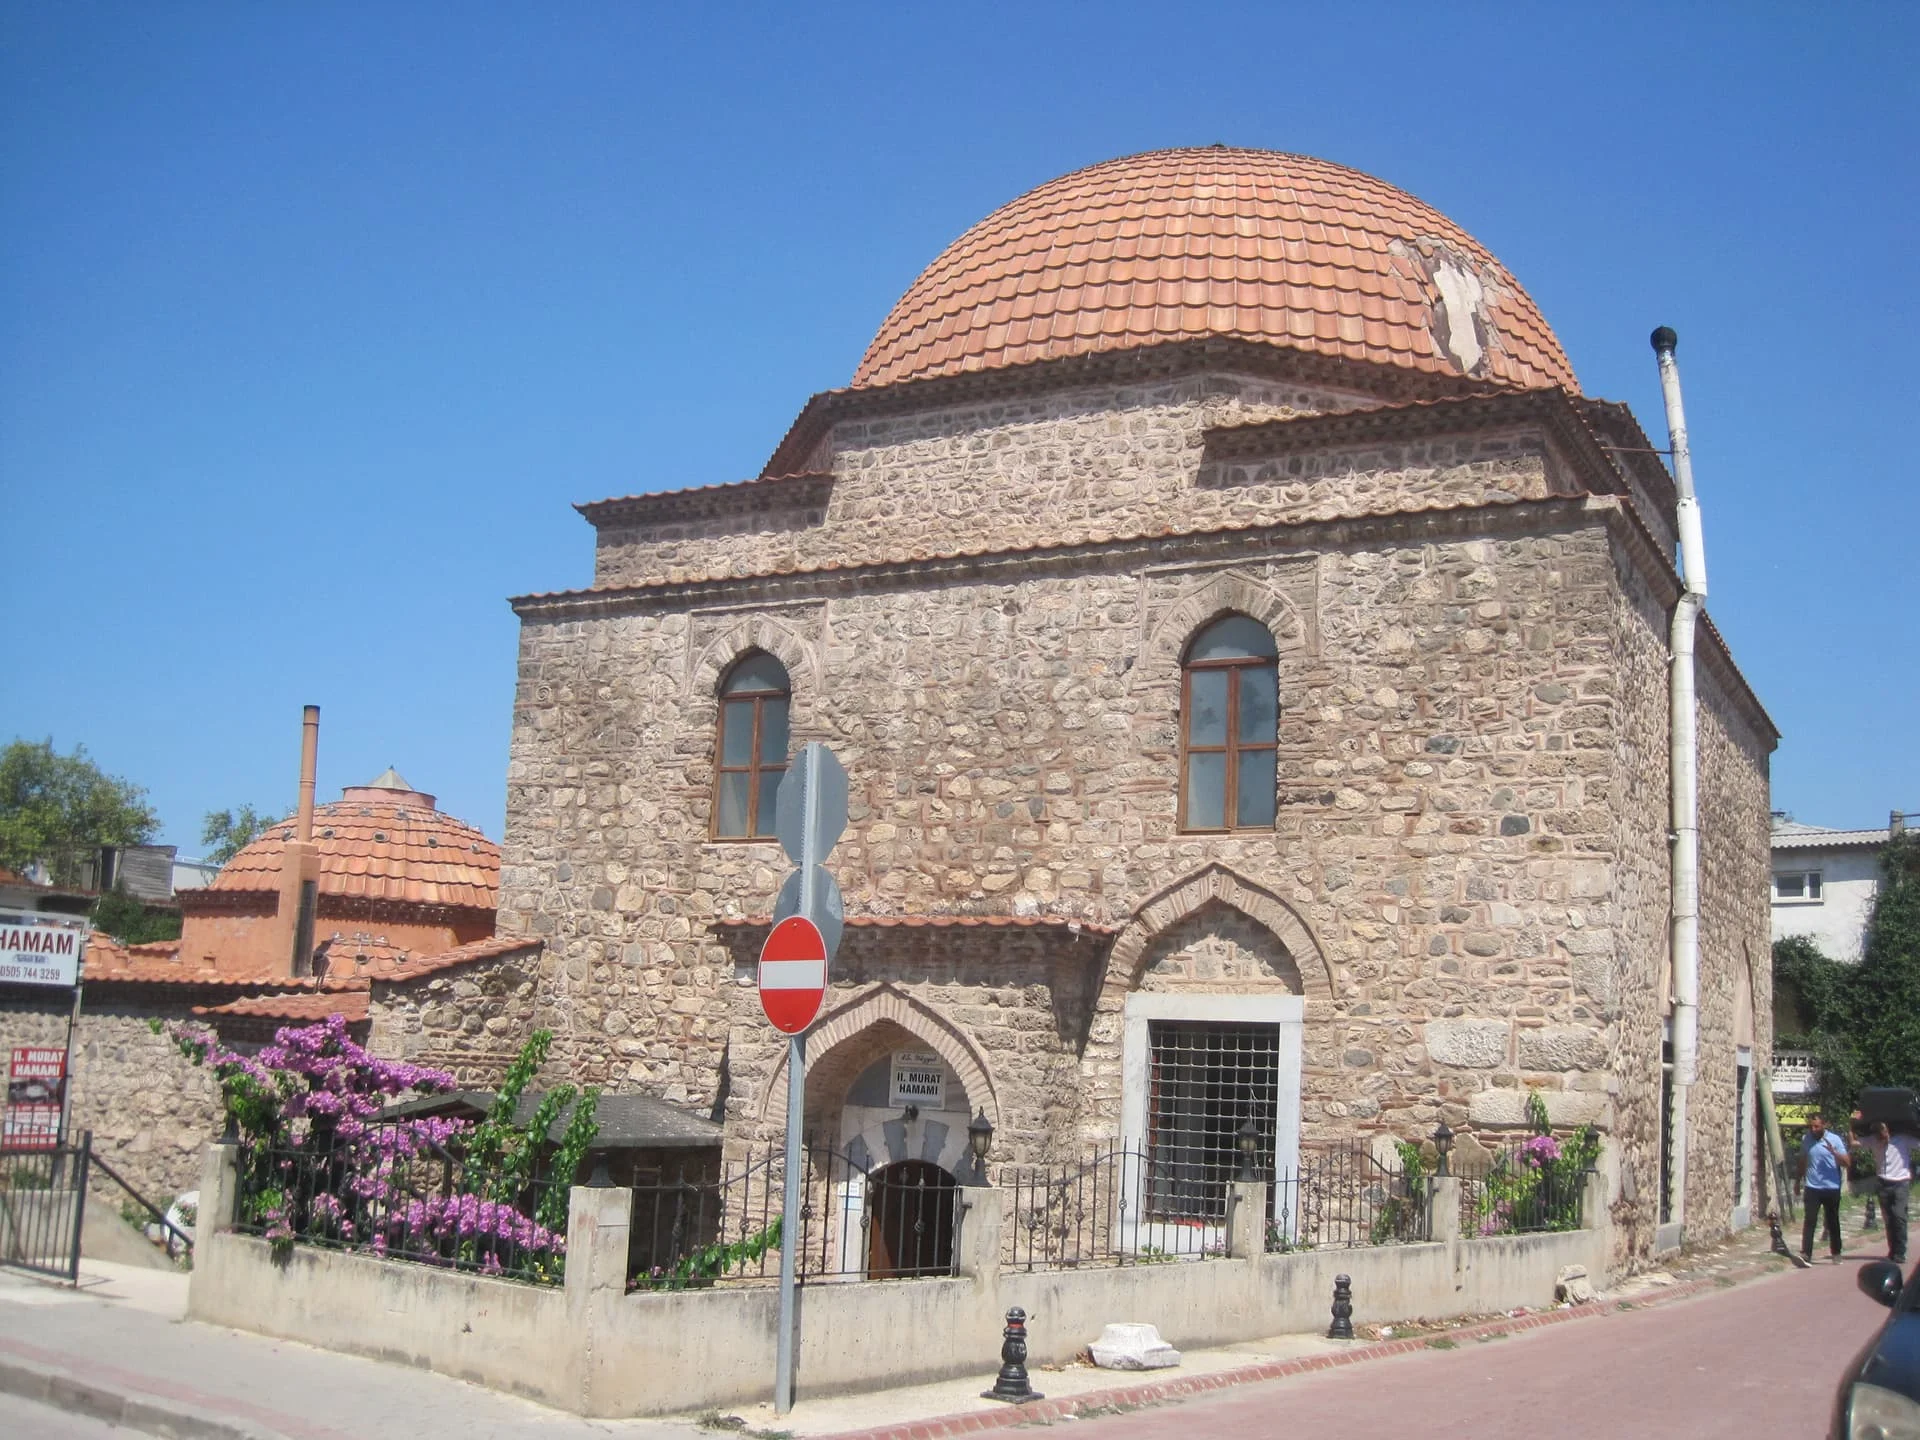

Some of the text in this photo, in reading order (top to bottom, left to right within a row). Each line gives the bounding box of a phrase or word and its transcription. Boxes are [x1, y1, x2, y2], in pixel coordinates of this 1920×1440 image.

[23, 966, 37, 978] 744
[40, 968, 60, 980] 3259
[28, 1050, 65, 1063] MURAT
[15, 1063, 60, 1076] HAMAMI
[897, 1071, 941, 1084] II. MURAT
[899, 1083, 938, 1095] HAMAMI
